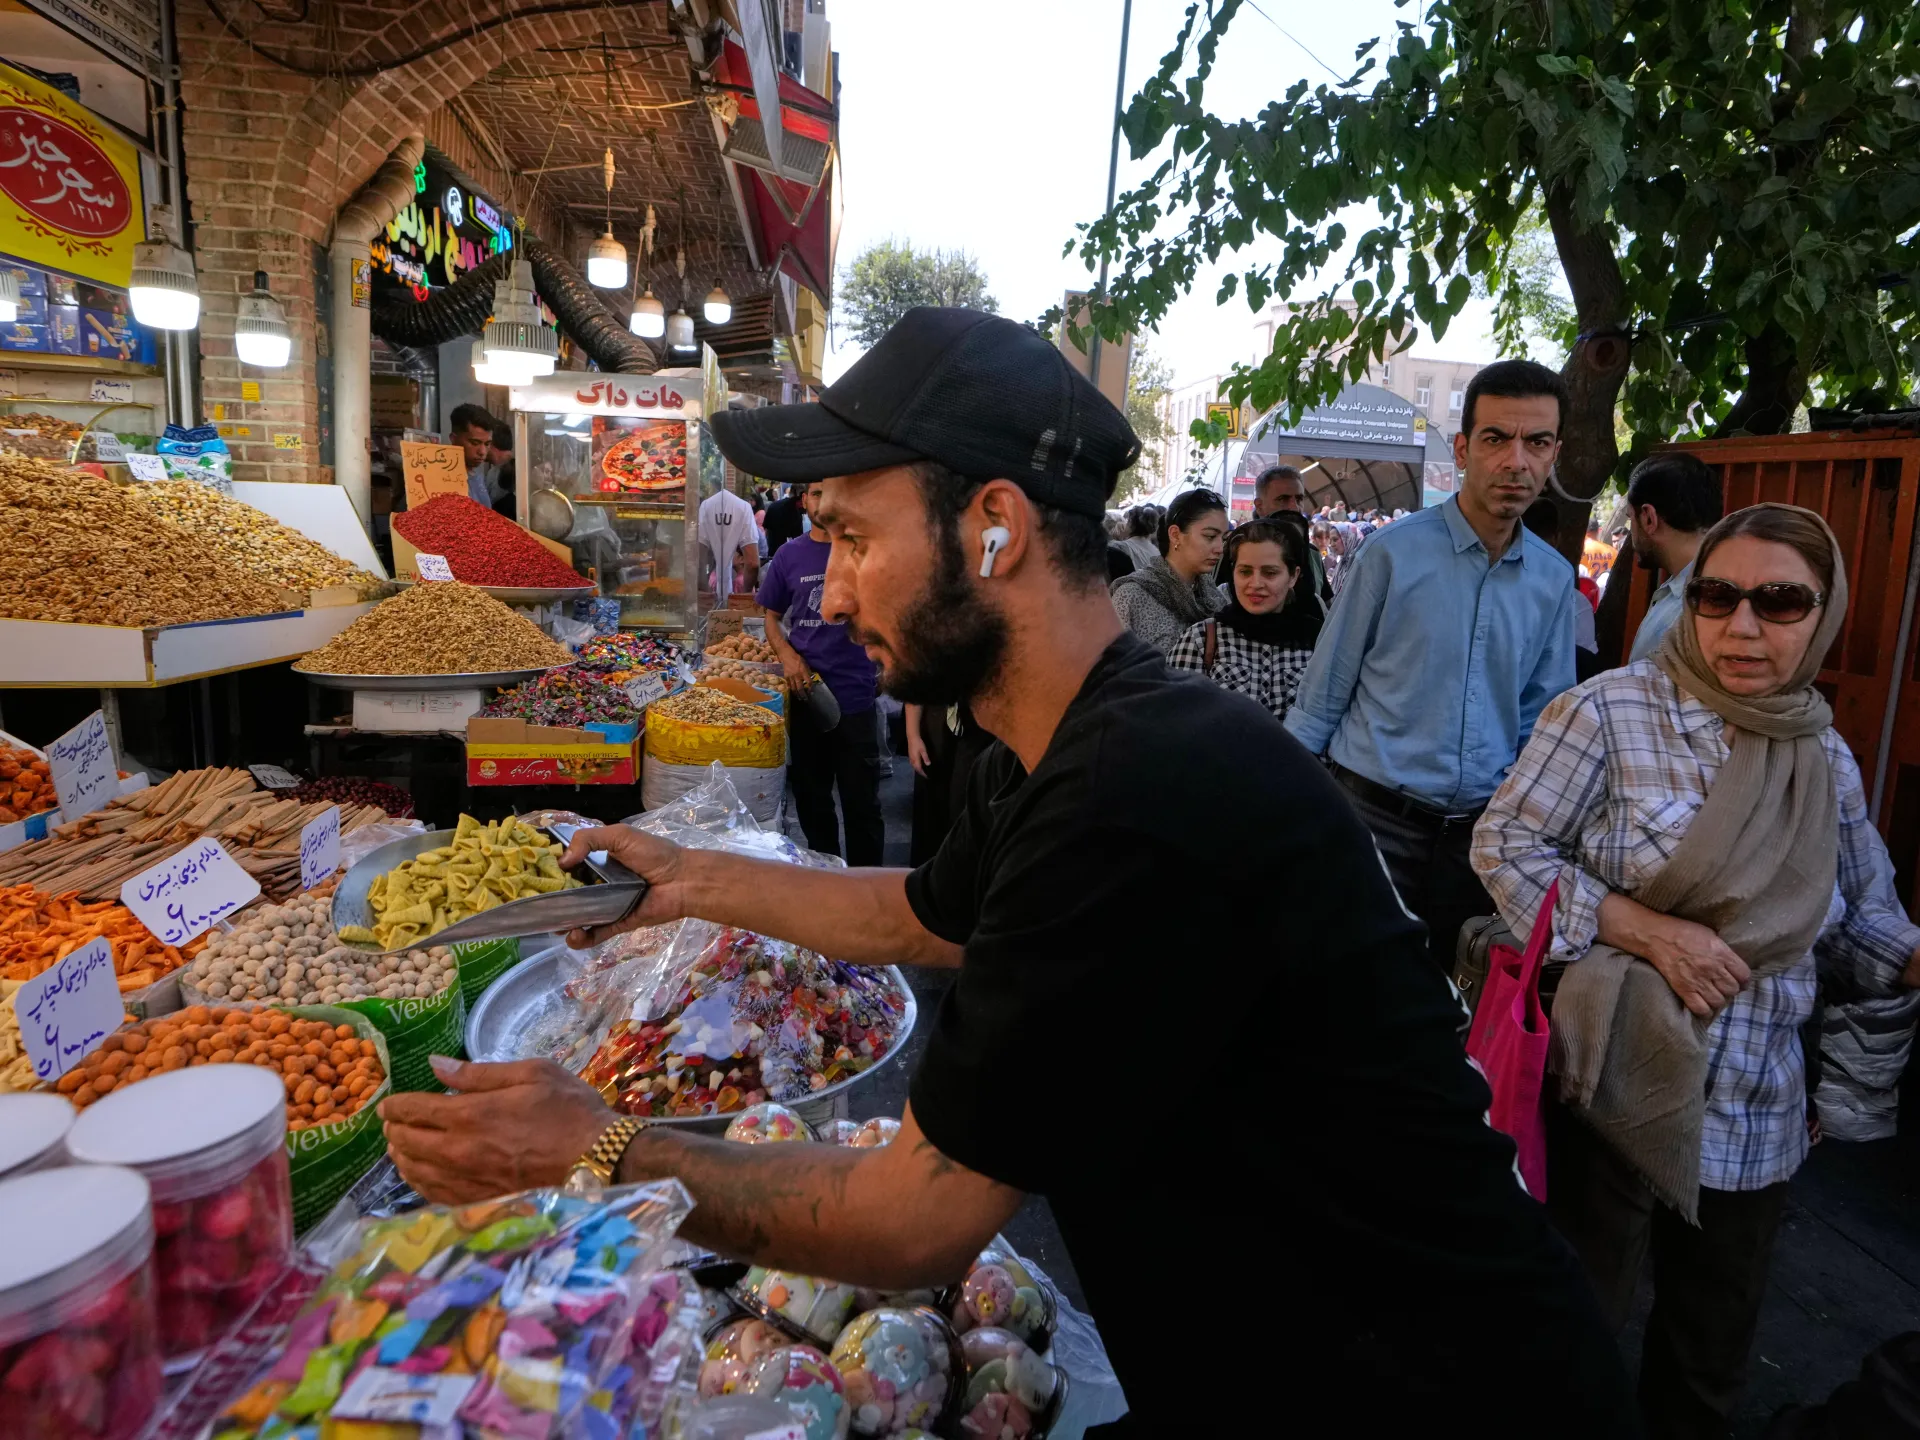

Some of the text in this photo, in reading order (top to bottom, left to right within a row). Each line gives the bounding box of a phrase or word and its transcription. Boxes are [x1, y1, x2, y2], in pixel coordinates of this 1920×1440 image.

[576, 380, 685, 410] هات داگ
[1377, 405, 1394, 415] خرداد
[98, 436, 120, 446] GREEN
[1363, 432, 1382, 440] شرقی
[1383, 433, 1403, 442] ورودی
[98, 447, 121, 457] RAISIN
[199, 846, 221, 873] بادام
[173, 859, 199, 886] زمینی
[27, 946, 107, 1024] بادام زمینی کچاپ
